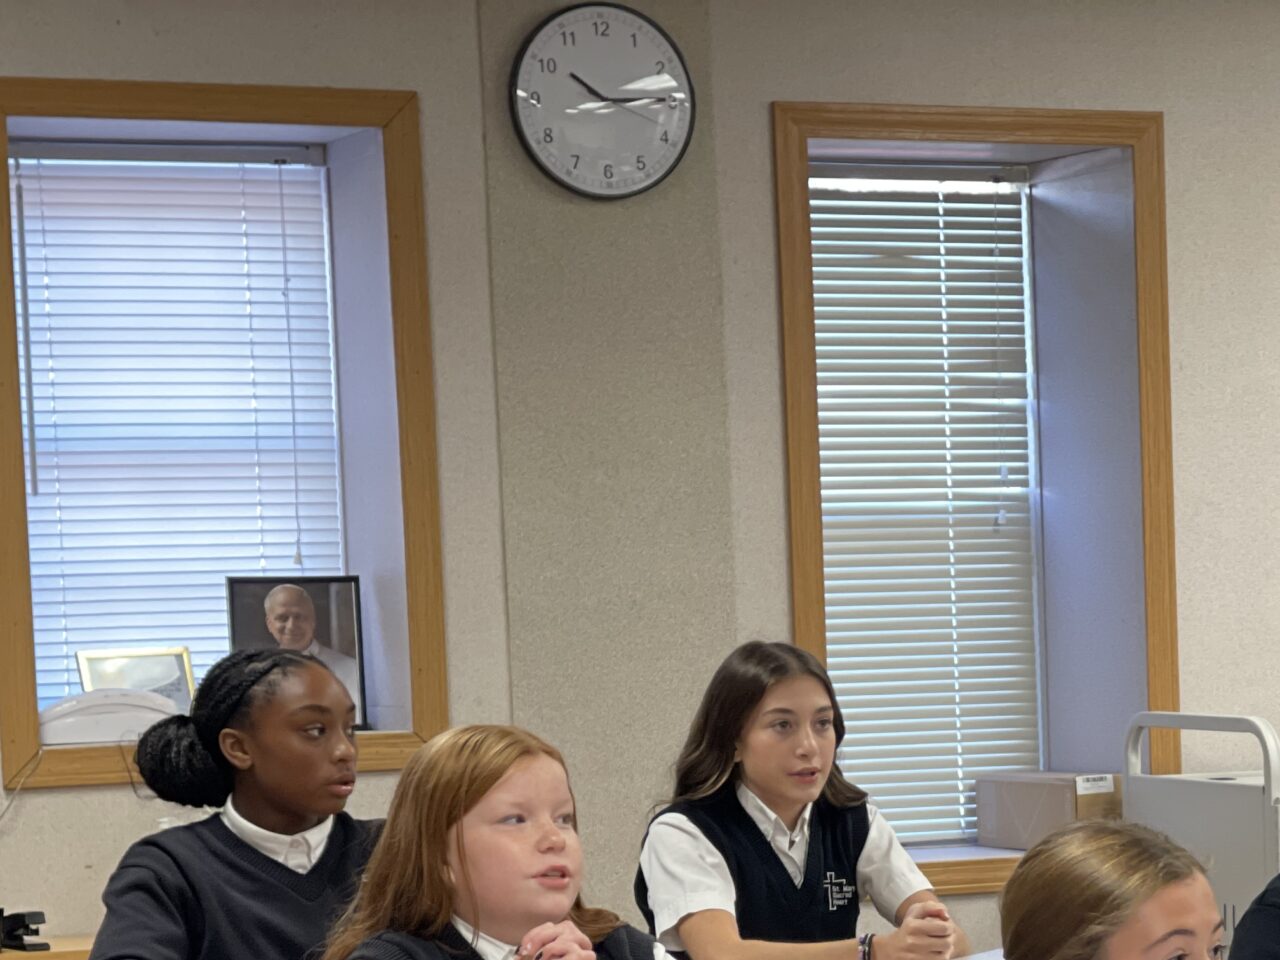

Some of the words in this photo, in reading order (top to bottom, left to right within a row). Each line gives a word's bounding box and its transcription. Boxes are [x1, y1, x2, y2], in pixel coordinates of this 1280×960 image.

[592, 21, 610, 37] 12
[561, 31, 576, 46] 11
[630, 33, 638, 48] 1
[538, 57, 557, 73] 10
[655, 60, 665, 75] 2
[530, 91, 541, 107] 9
[543, 128, 553, 143] 8
[660, 130, 669, 144] 4
[570, 154, 580, 170] 7
[636, 155, 646, 170] 5
[603, 164, 614, 179] 6
